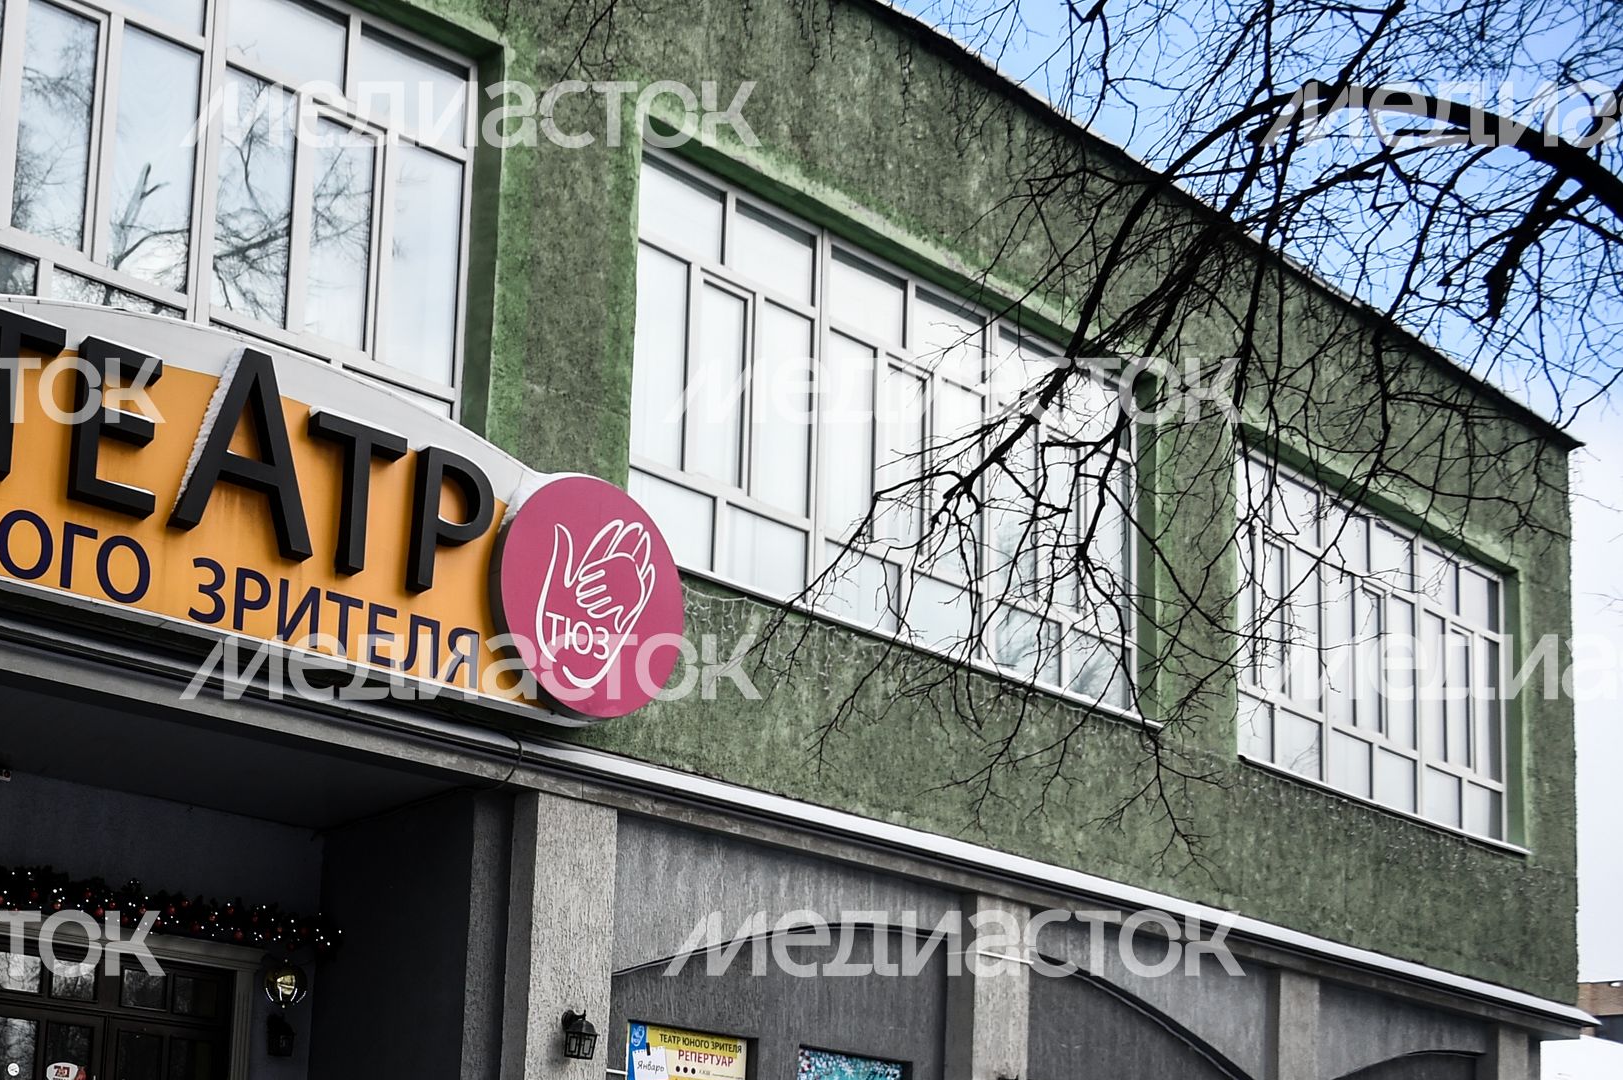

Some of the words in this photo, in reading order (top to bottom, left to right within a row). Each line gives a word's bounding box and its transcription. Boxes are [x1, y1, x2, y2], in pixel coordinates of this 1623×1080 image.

[188, 556, 480, 690] ЗРИТЕЛЯ
[546, 612, 610, 660] ТЮЗ
[659, 1033, 681, 1044] ТЕАТР
[682, 1037, 709, 1049] ЮНОГО
[711, 1041, 742, 1053] ЗРИТЕЛЯ
[678, 1049, 734, 1067] РЕПЕРТУАР
